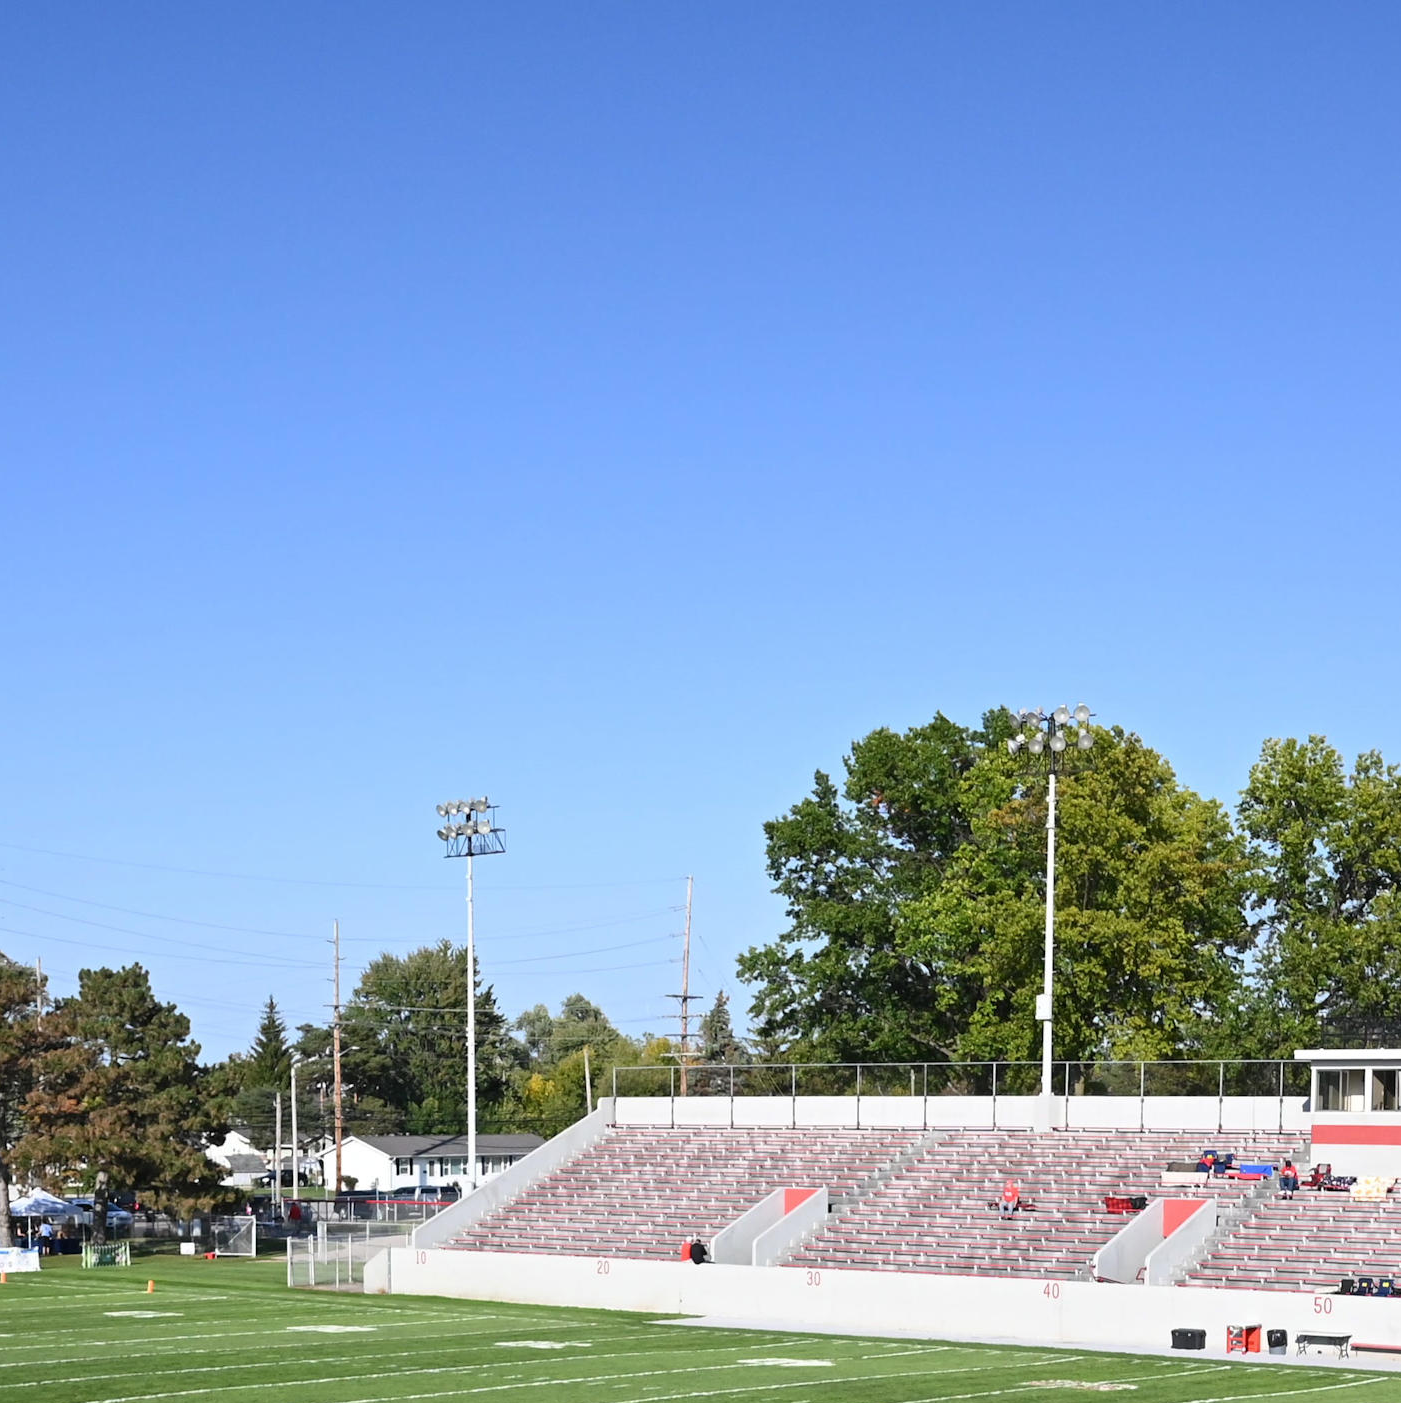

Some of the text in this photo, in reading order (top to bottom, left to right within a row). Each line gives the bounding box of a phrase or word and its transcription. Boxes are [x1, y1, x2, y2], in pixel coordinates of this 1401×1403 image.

[415, 1250, 428, 1265] 10
[597, 1260, 610, 1275] 20
[806, 1271, 821, 1287] 30
[1043, 1282, 1061, 1299] 40
[1313, 1296, 1333, 1314] 50
